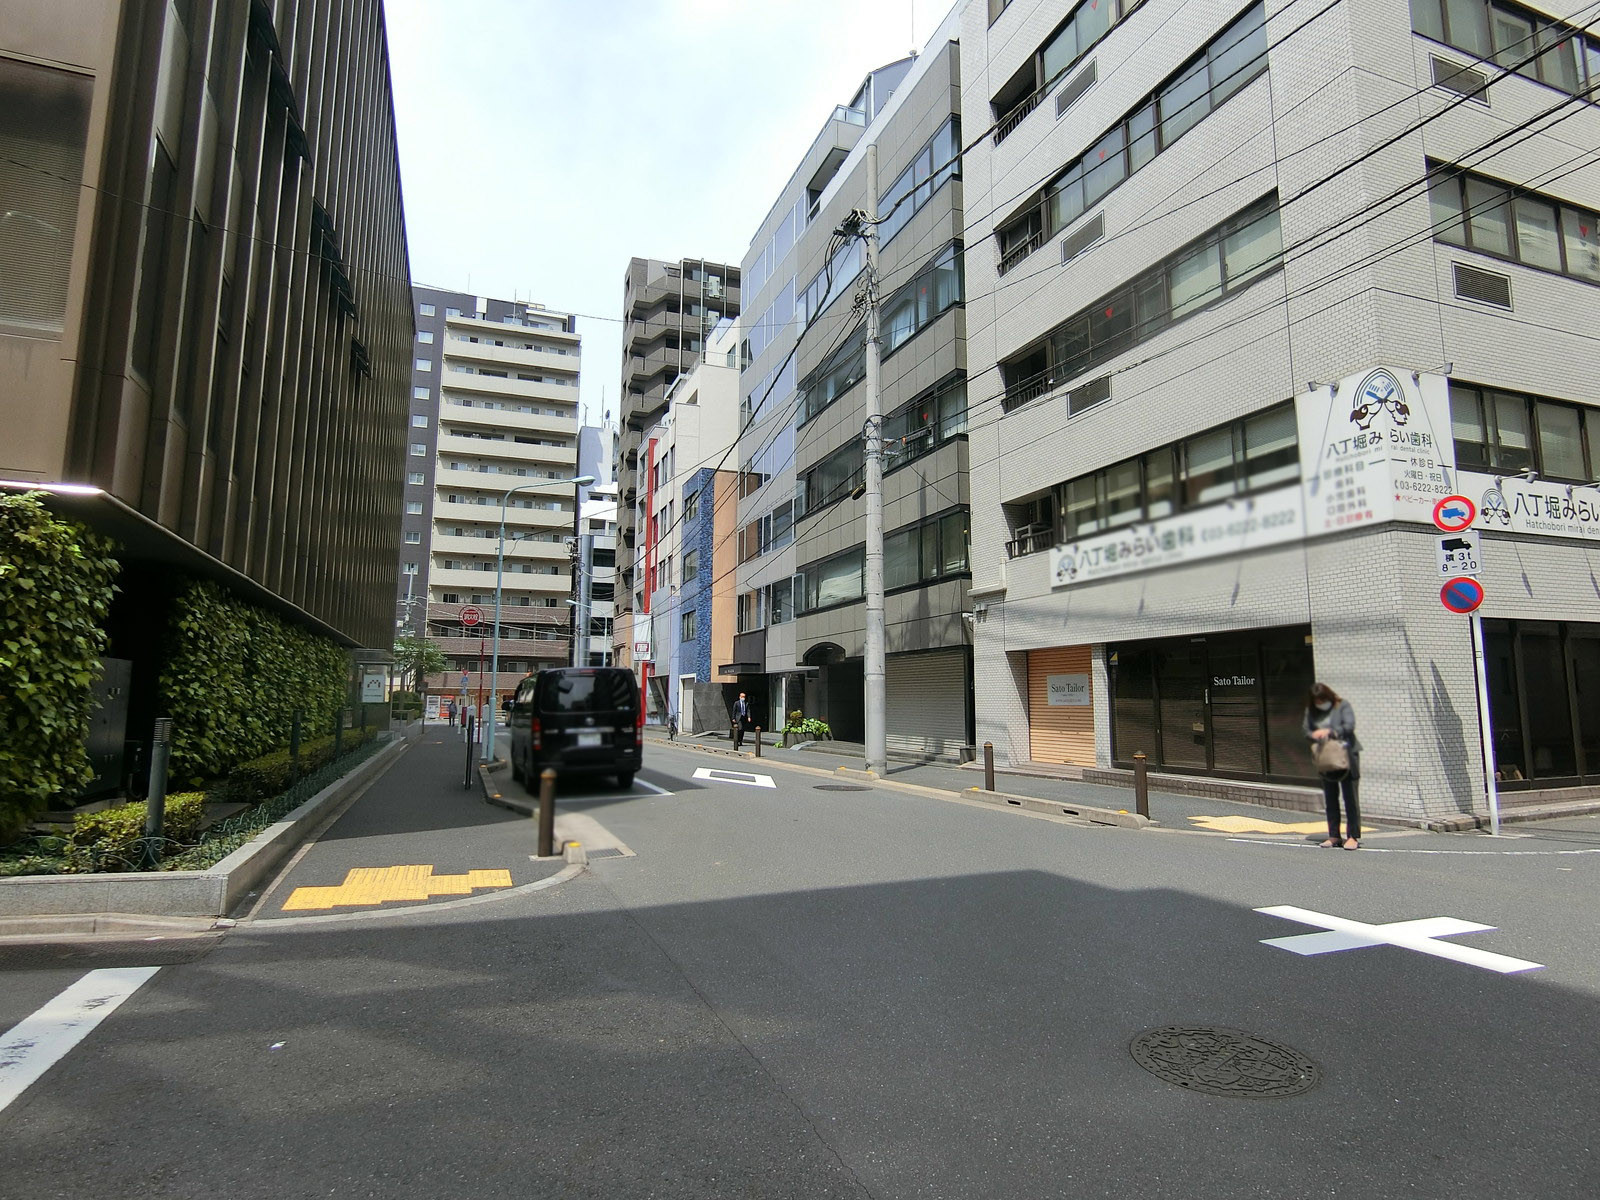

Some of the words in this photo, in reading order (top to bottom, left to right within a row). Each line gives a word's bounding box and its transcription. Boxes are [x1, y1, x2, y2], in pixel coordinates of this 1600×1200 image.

[1326, 431, 1383, 459] 八丁堀み
[1390, 428, 1432, 448] らい歯科
[1410, 457, 1434, 469] 休診日
[1399, 480, 1453, 495] 03-6222-8222
[1525, 519, 1566, 532] Hatchobori
[1213, 676, 1231, 686] Sato
[1232, 675, 1255, 686] Tailor
[1051, 683, 1065, 693] Sato
[1066, 683, 1085, 693] Tailor
